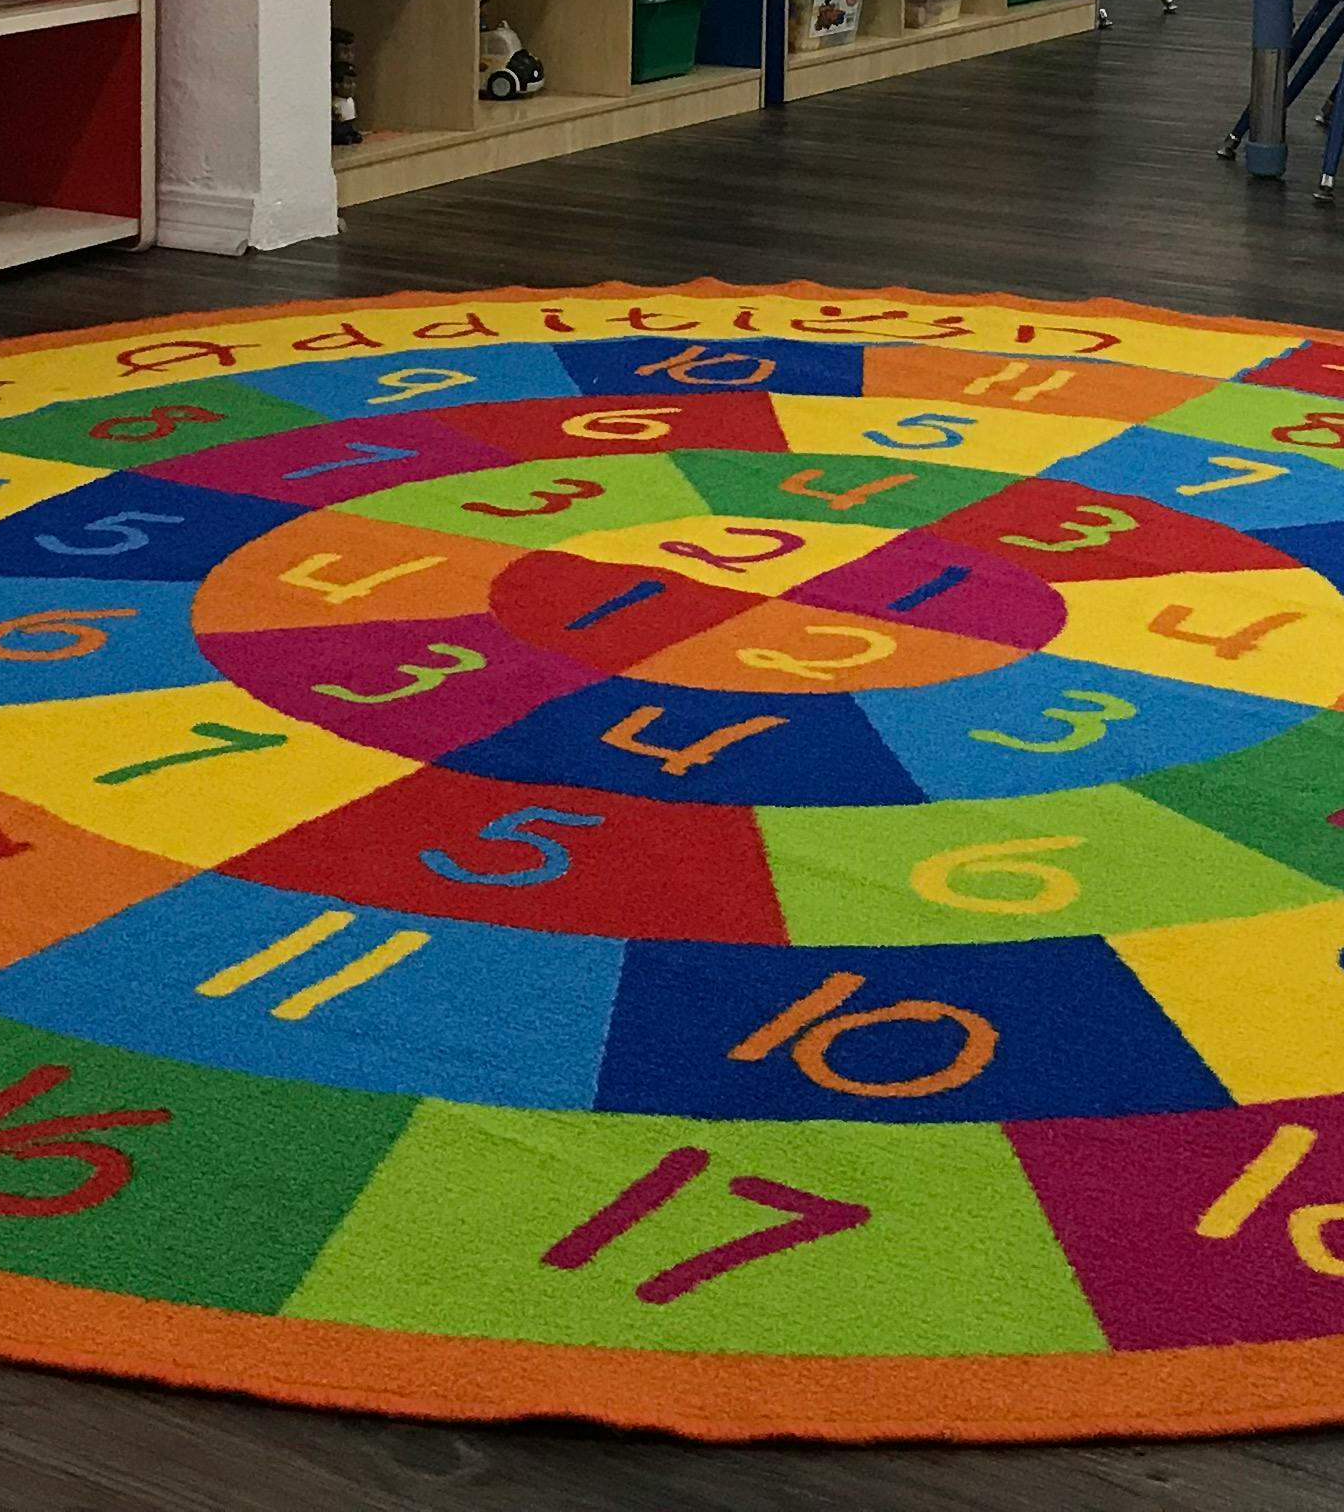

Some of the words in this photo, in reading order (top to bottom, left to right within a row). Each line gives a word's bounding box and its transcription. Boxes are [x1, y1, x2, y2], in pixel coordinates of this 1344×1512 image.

[367, 367, 478, 405] 9
[636, 345, 777, 387] 10
[963, 361, 1079, 402] 11
[90, 404, 225, 443] 8
[561, 406, 683, 441] 6
[862, 412, 978, 451] 5
[282, 441, 420, 481] 7
[1177, 455, 1291, 497] 7
[461, 476, 606, 518] 3
[779, 468, 918, 511] 4
[34, 510, 185, 557] 5
[659, 526, 805, 573] 2
[999, 503, 1140, 553] 3
[278, 552, 449, 605] 4
[887, 564, 971, 613] 1
[564, 579, 666, 631] 1
[734, 624, 899, 682] 2
[1148, 603, 1307, 661] 4
[311, 642, 488, 704] 3
[599, 705, 792, 776] 4
[967, 689, 1138, 754] 3
[93, 721, 288, 786] 7
[417, 805, 605, 888] 5
[909, 835, 1089, 916] 6
[194, 908, 433, 1022] 11
[726, 971, 1001, 1100] 10
[540, 1146, 873, 1307] 17
